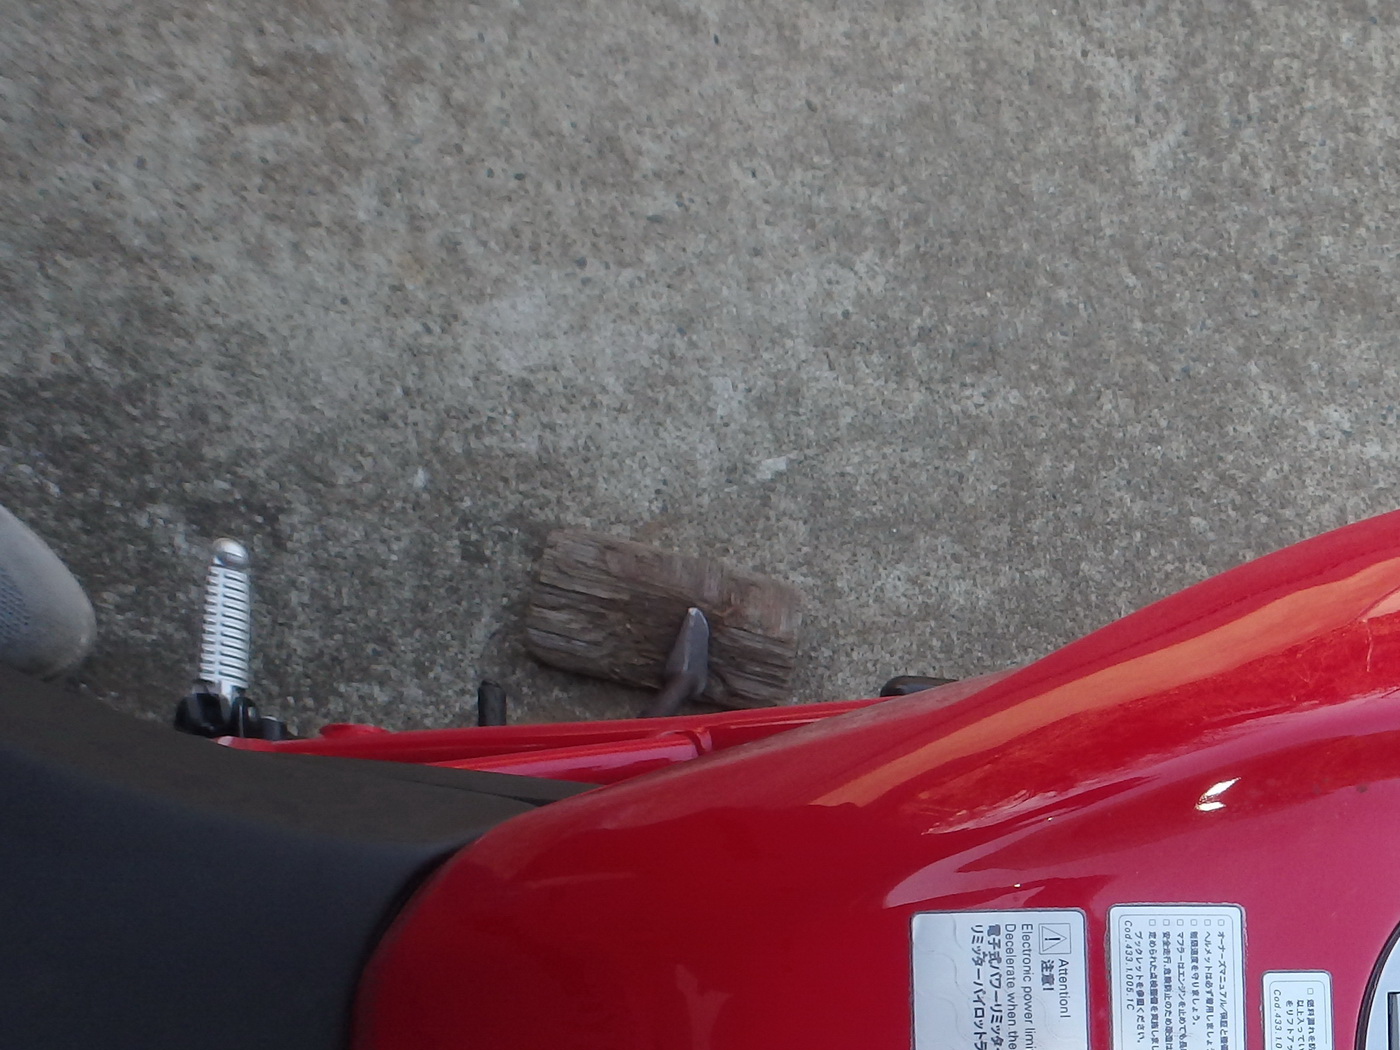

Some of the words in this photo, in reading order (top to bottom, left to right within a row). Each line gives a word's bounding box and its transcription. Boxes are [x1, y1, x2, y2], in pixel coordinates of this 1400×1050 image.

[1005, 923, 1017, 988] Decelerate
[1021, 923, 1034, 982] Electronic
[1007, 992, 1018, 1026] when
[1021, 986, 1033, 1024] power
[1058, 958, 1071, 1018] Attention!
[1008, 1031, 1019, 1050] the
